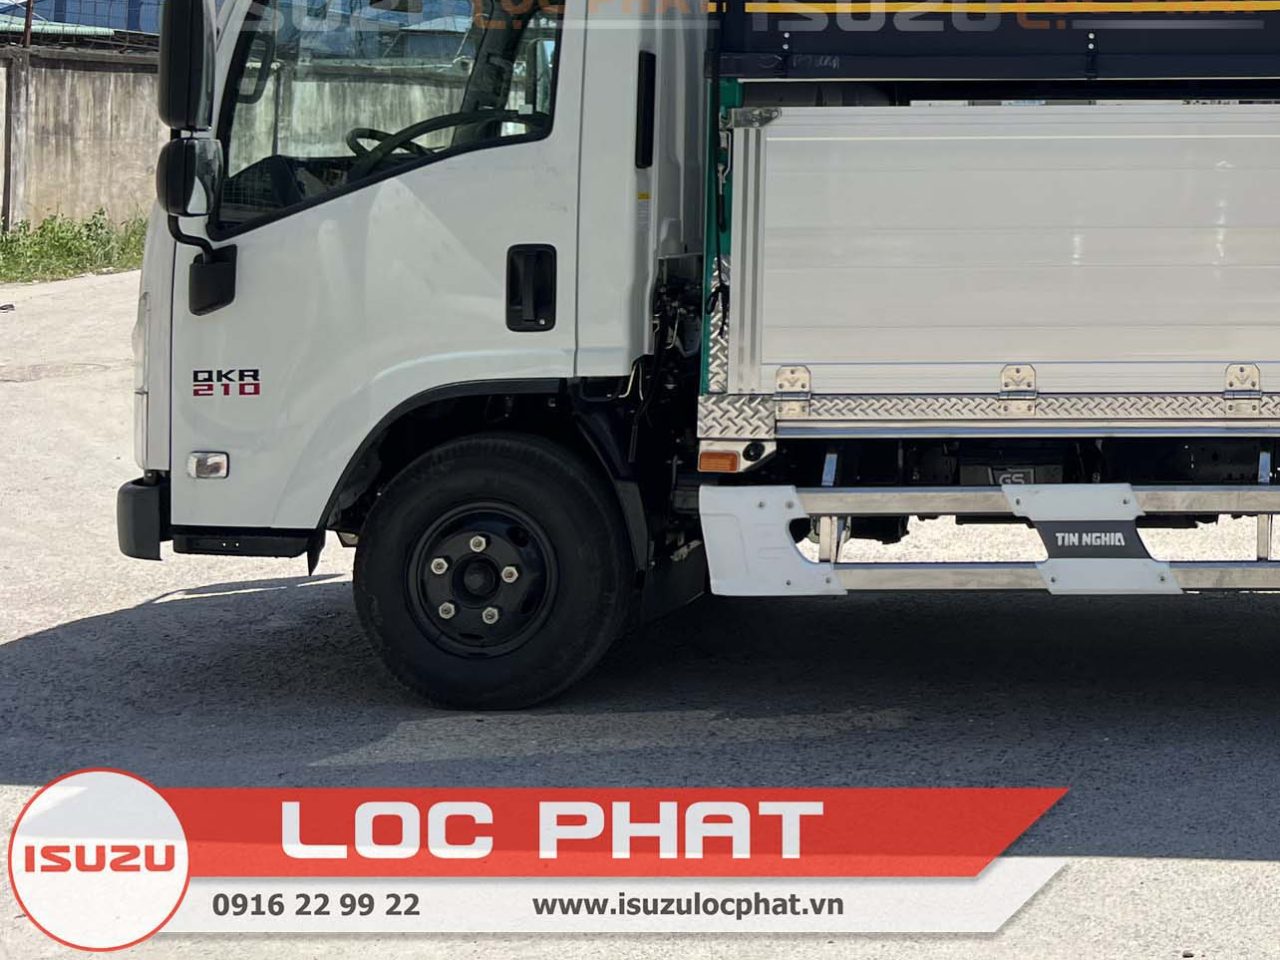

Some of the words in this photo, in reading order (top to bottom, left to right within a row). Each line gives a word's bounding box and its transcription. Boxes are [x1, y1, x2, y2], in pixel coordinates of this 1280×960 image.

[193, 369, 260, 383] QKR
[193, 383, 260, 397] 210
[1055, 532, 1079, 547] TIN
[1082, 532, 1125, 547] NGHIA
